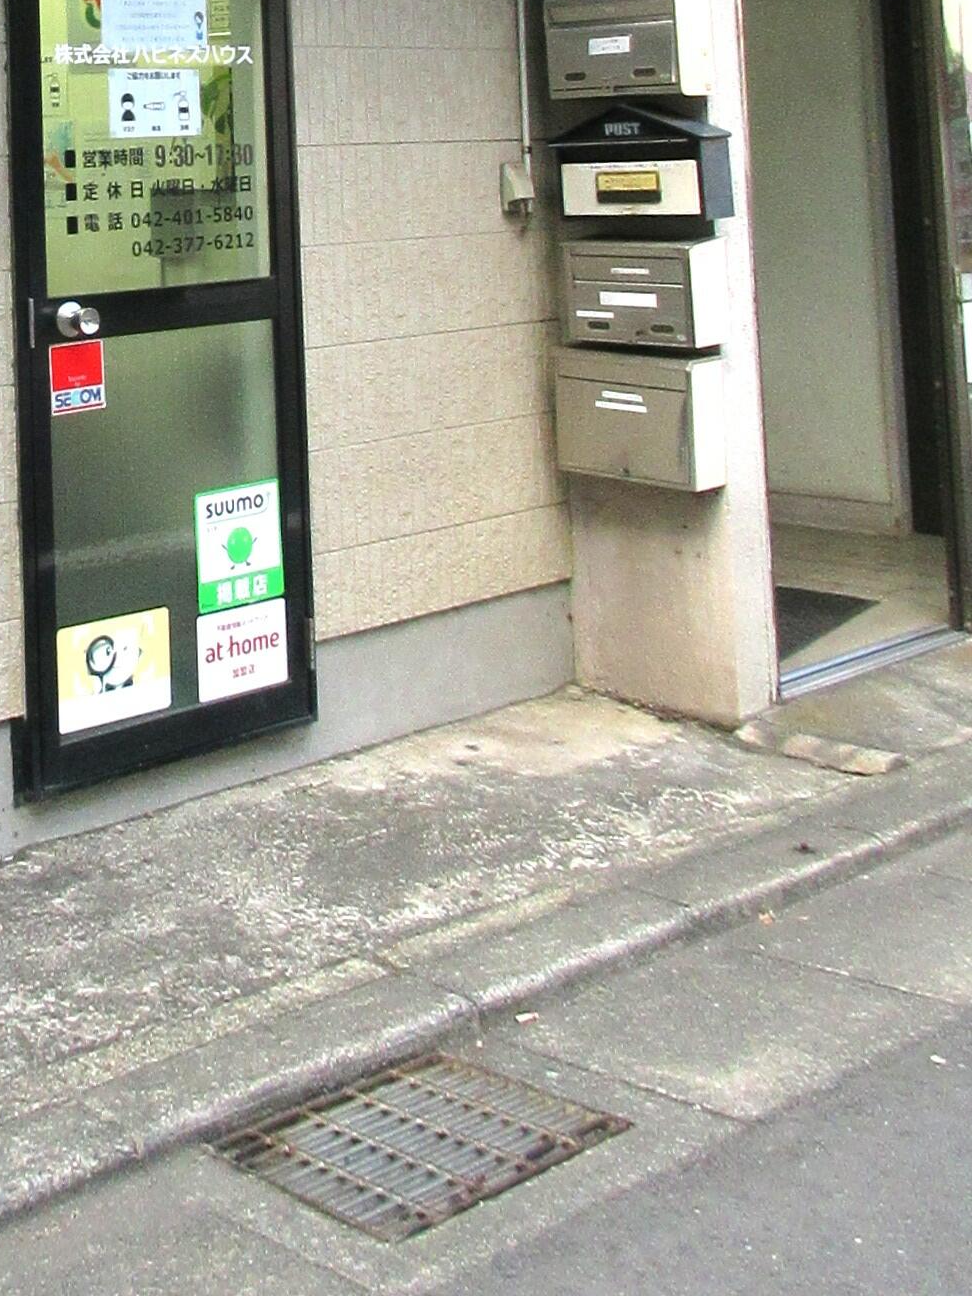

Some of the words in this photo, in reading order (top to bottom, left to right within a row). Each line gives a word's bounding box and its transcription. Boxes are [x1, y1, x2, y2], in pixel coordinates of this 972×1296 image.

[54, 43, 254, 65] 株式会社ハピネスハウス
[604, 122, 641, 137] POST
[82, 147, 145, 170] 営業時間
[131, 205, 254, 230] 042-401-5840
[132, 232, 255, 258] 042-377-6212
[54, 387, 101, 409] SECOM
[205, 641, 224, 664] at
[228, 631, 280, 658] home
